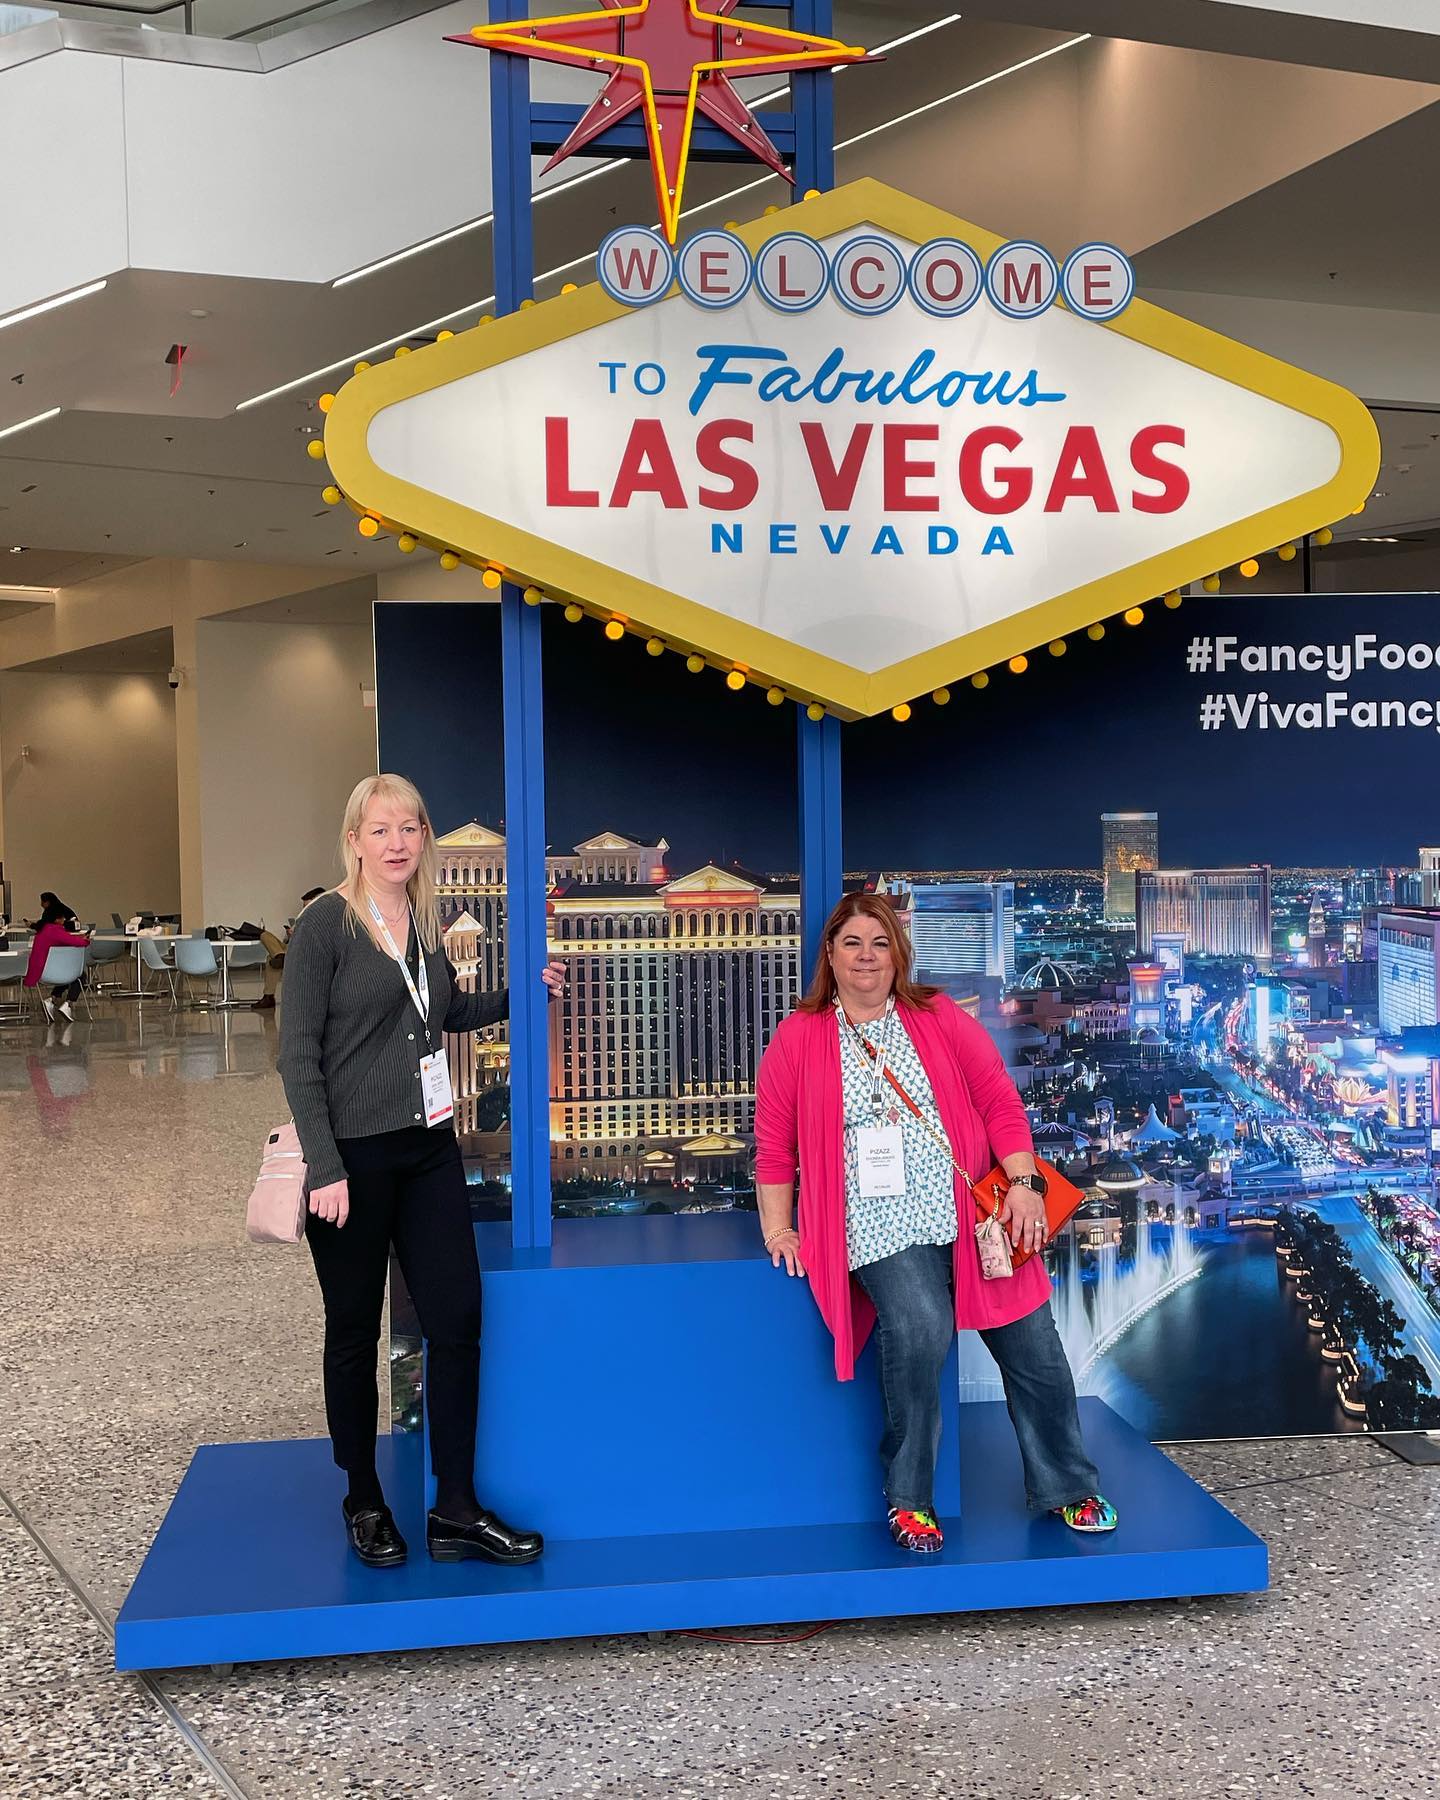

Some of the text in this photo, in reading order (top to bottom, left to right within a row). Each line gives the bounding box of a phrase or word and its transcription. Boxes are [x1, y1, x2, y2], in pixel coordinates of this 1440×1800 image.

[612, 247, 1113, 306] WELCOME
[599, 344, 1067, 416] TO Fabulous
[545, 416, 1190, 515] LAS VEGAS
[711, 523, 1014, 556] NEVADA
[1186, 634, 1440, 682] #FancyFoo
[1199, 692, 1440, 736] #VivaFanc
